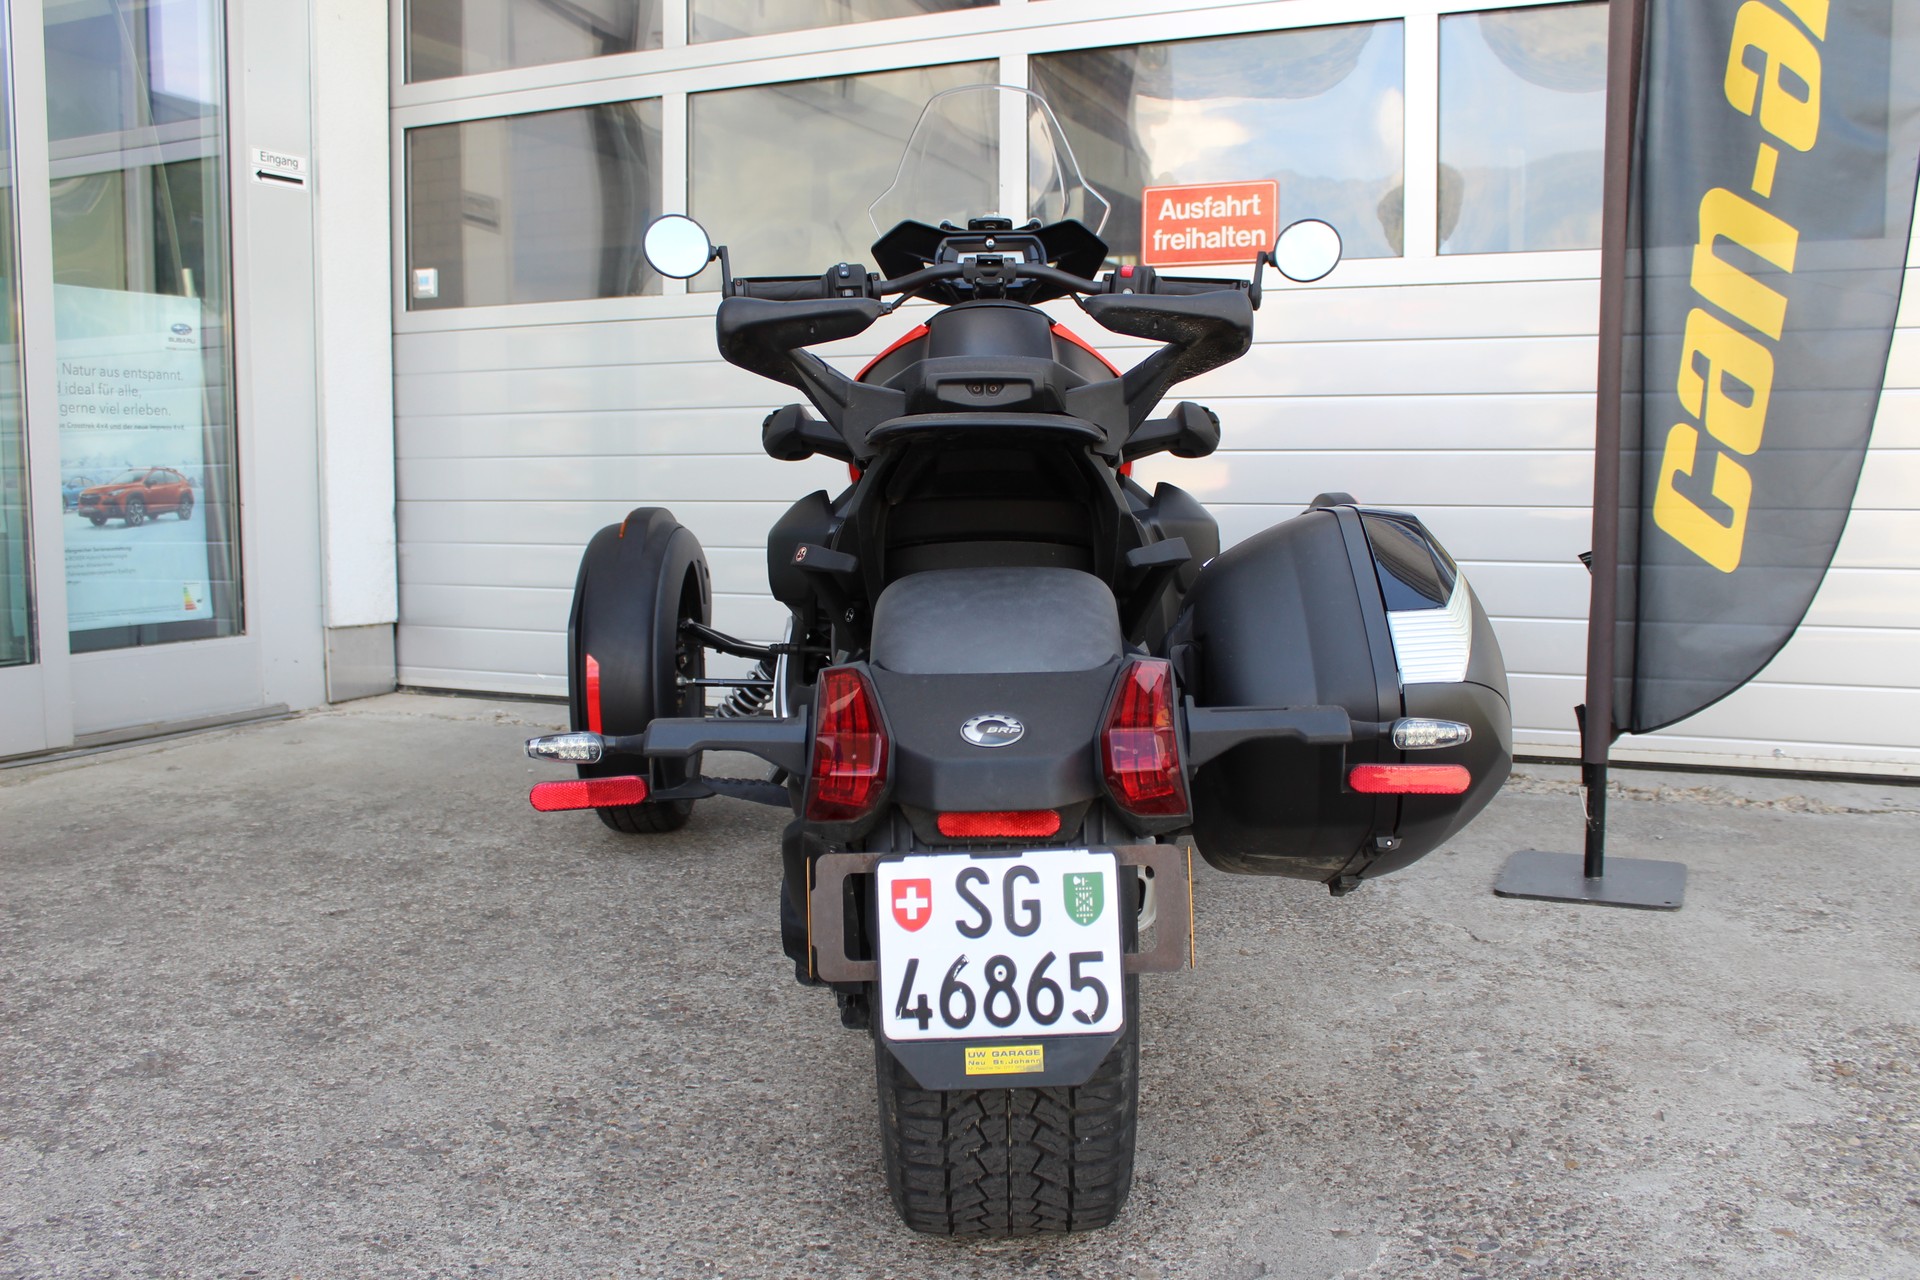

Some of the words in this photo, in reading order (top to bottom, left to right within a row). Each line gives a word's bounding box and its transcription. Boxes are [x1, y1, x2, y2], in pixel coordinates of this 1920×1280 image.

[260, 150, 299, 170] Eingang
[1158, 194, 1261, 221] Ausfahrt
[1153, 225, 1266, 251] freihalten
[1653, 0, 1830, 573] can-a
[62, 362, 97, 377] Natur
[100, 367, 120, 378] aus
[122, 368, 183, 382] entspannt.
[65, 381, 95, 395] ideal
[98, 382, 115, 396] für
[117, 383, 142, 399] alle,
[59, 403, 96, 417] gerne
[99, 402, 120, 415] viel
[122, 403, 172, 416] erleben.
[986, 726, 1021, 734] BRP
[955, 865, 1041, 939] SG
[895, 951, 1109, 1031] 46865
